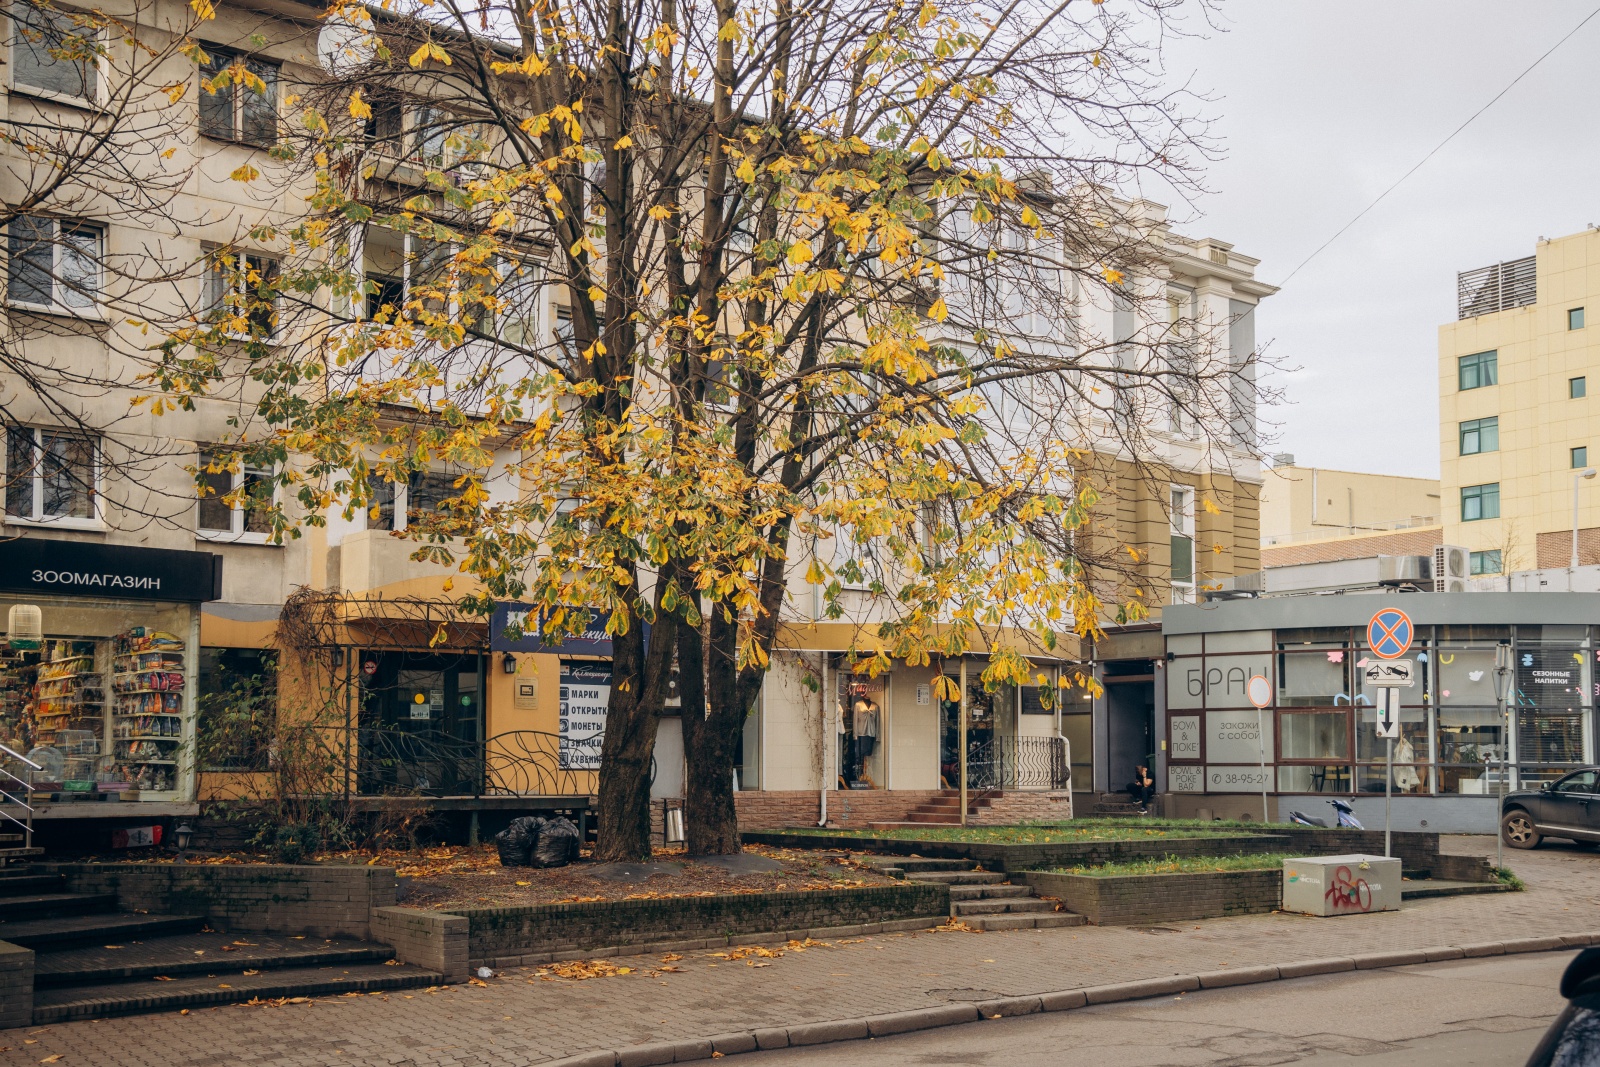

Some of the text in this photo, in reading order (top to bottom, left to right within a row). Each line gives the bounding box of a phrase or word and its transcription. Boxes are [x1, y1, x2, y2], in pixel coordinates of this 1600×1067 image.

[32, 570, 160, 589] ЗООМАГАЗИН
[571, 690, 599, 699] МАРКИ
[571, 706, 608, 715] ОТКРЫТК
[571, 722, 602, 731] МОНЕТЫ
[1172, 721, 1197, 731] БОУЛ
[1220, 722, 1259, 730] закажи
[1181, 732, 1189, 741] &
[1218, 731, 1261, 740] с собой
[571, 739, 602, 748] ЗНАЧКИ
[1170, 766, 1193, 775] BOWL
[1175, 775, 1197, 783] POKE
[1225, 774, 1269, 784] 38-95-27
[1178, 783, 1194, 791] BAR
